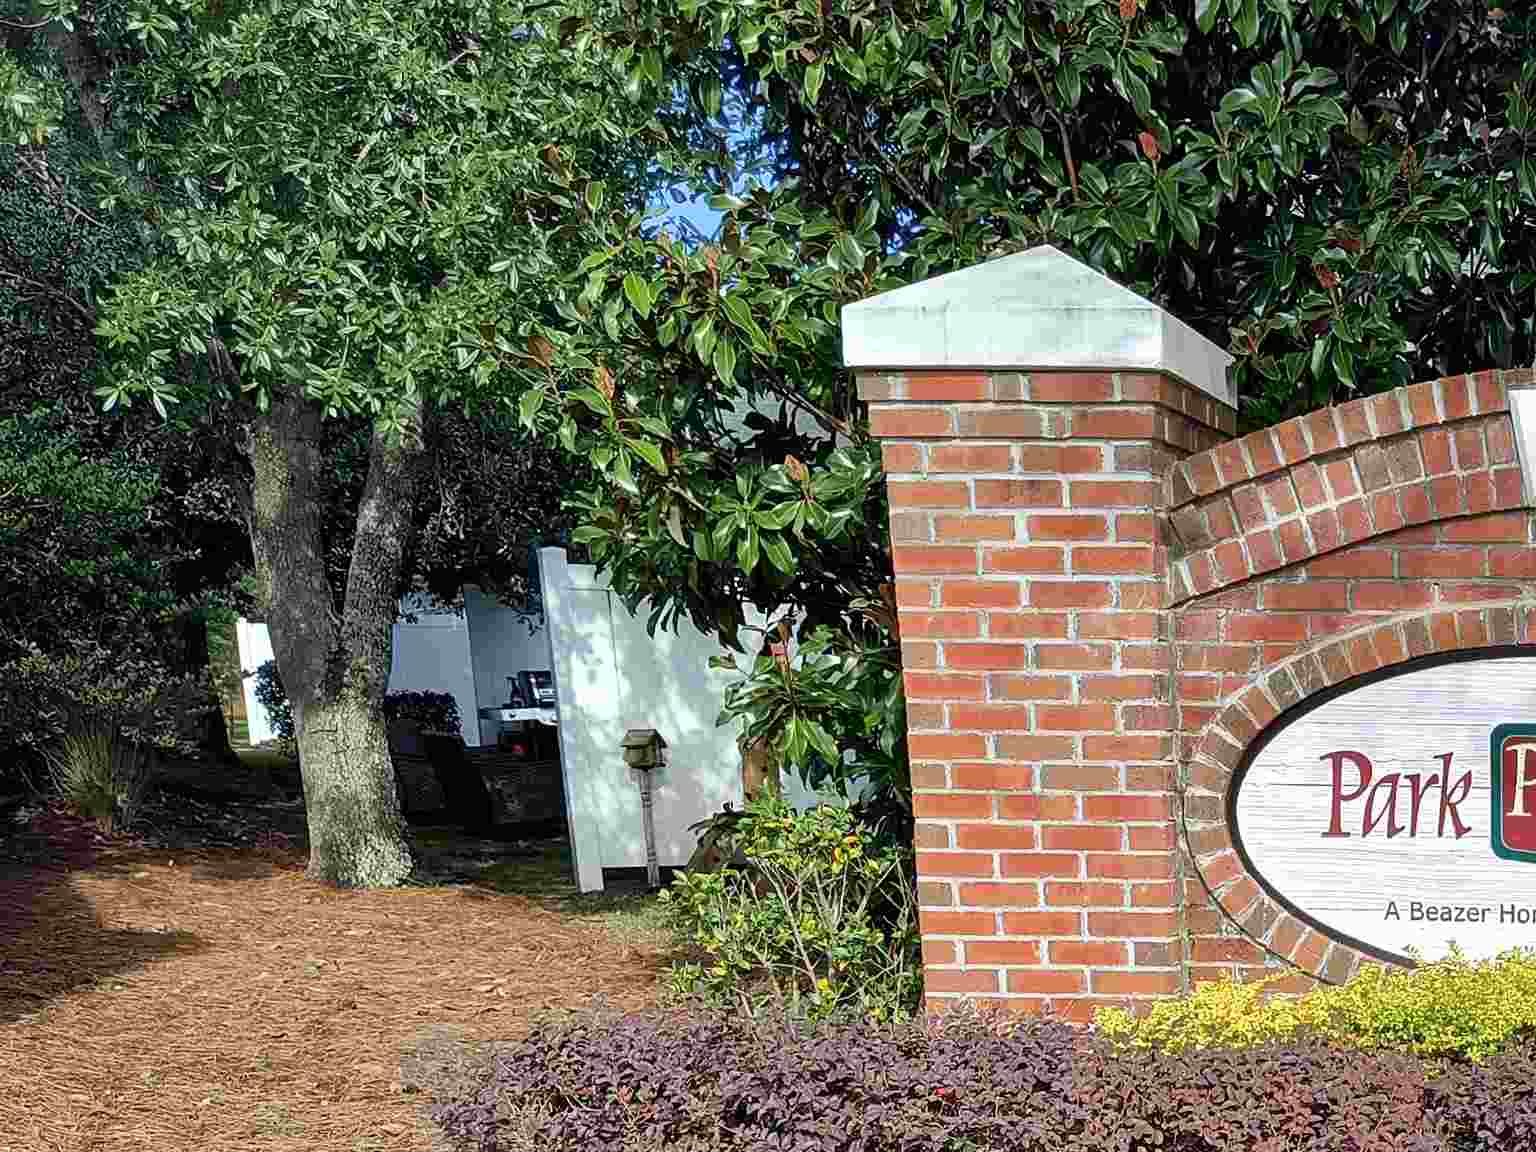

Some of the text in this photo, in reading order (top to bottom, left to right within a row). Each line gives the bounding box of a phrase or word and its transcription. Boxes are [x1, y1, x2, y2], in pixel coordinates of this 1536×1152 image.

[1320, 750, 1473, 839] Park
[1384, 902, 1400, 921] A
[1410, 902, 1490, 923] Beazer
